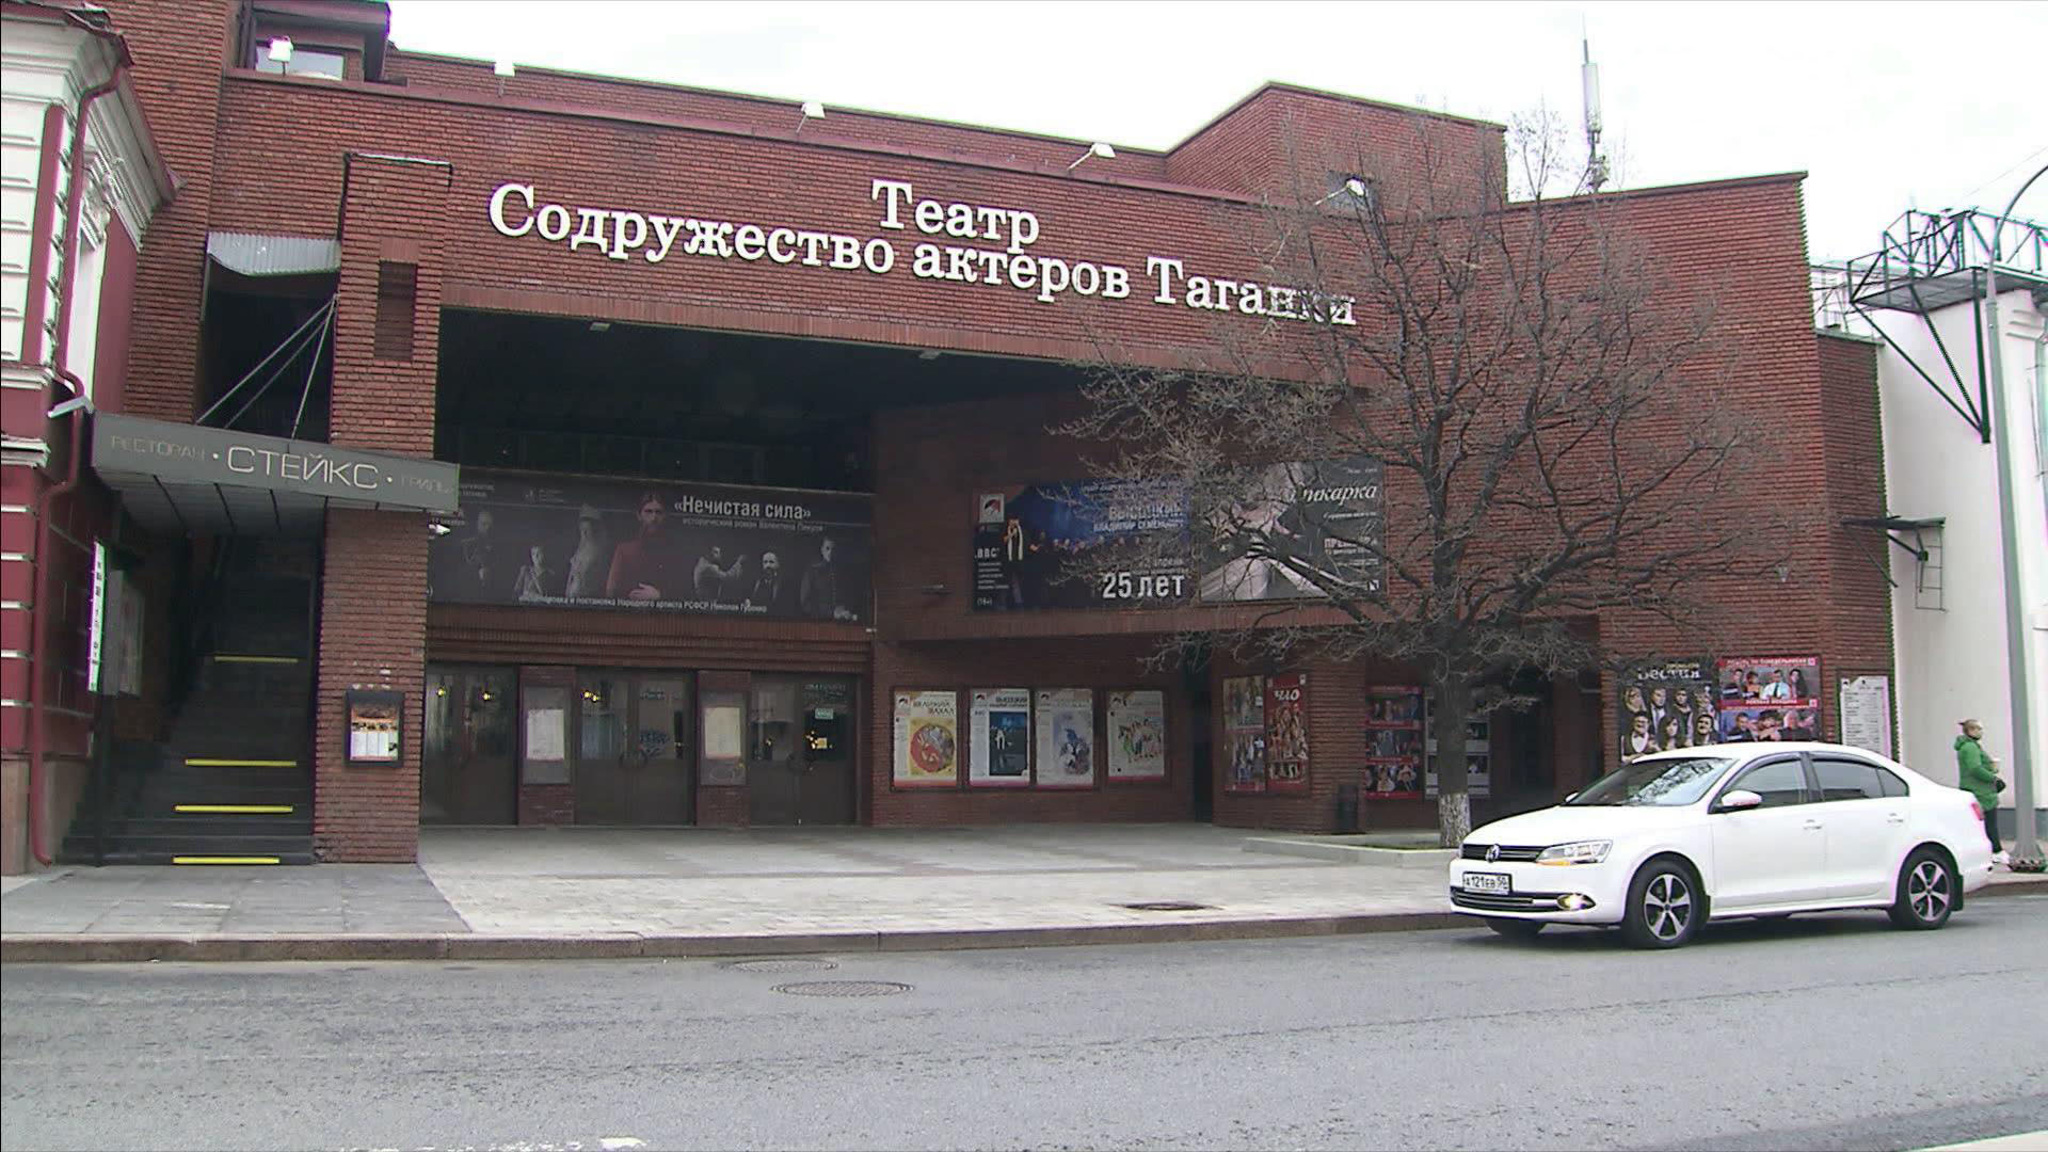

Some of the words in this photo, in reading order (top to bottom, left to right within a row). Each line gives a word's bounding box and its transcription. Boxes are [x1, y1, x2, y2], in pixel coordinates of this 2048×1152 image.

[871, 178, 1040, 254] Театр
[488, 183, 896, 273] Содружество
[912, 243, 1131, 303] актеров
[227, 446, 378, 490] СТЕЙКС
[674, 495, 760, 518] «Нечистая
[764, 504, 811, 520] сила»
[1102, 571, 1132, 599] 25
[1137, 574, 1184, 597] лет
